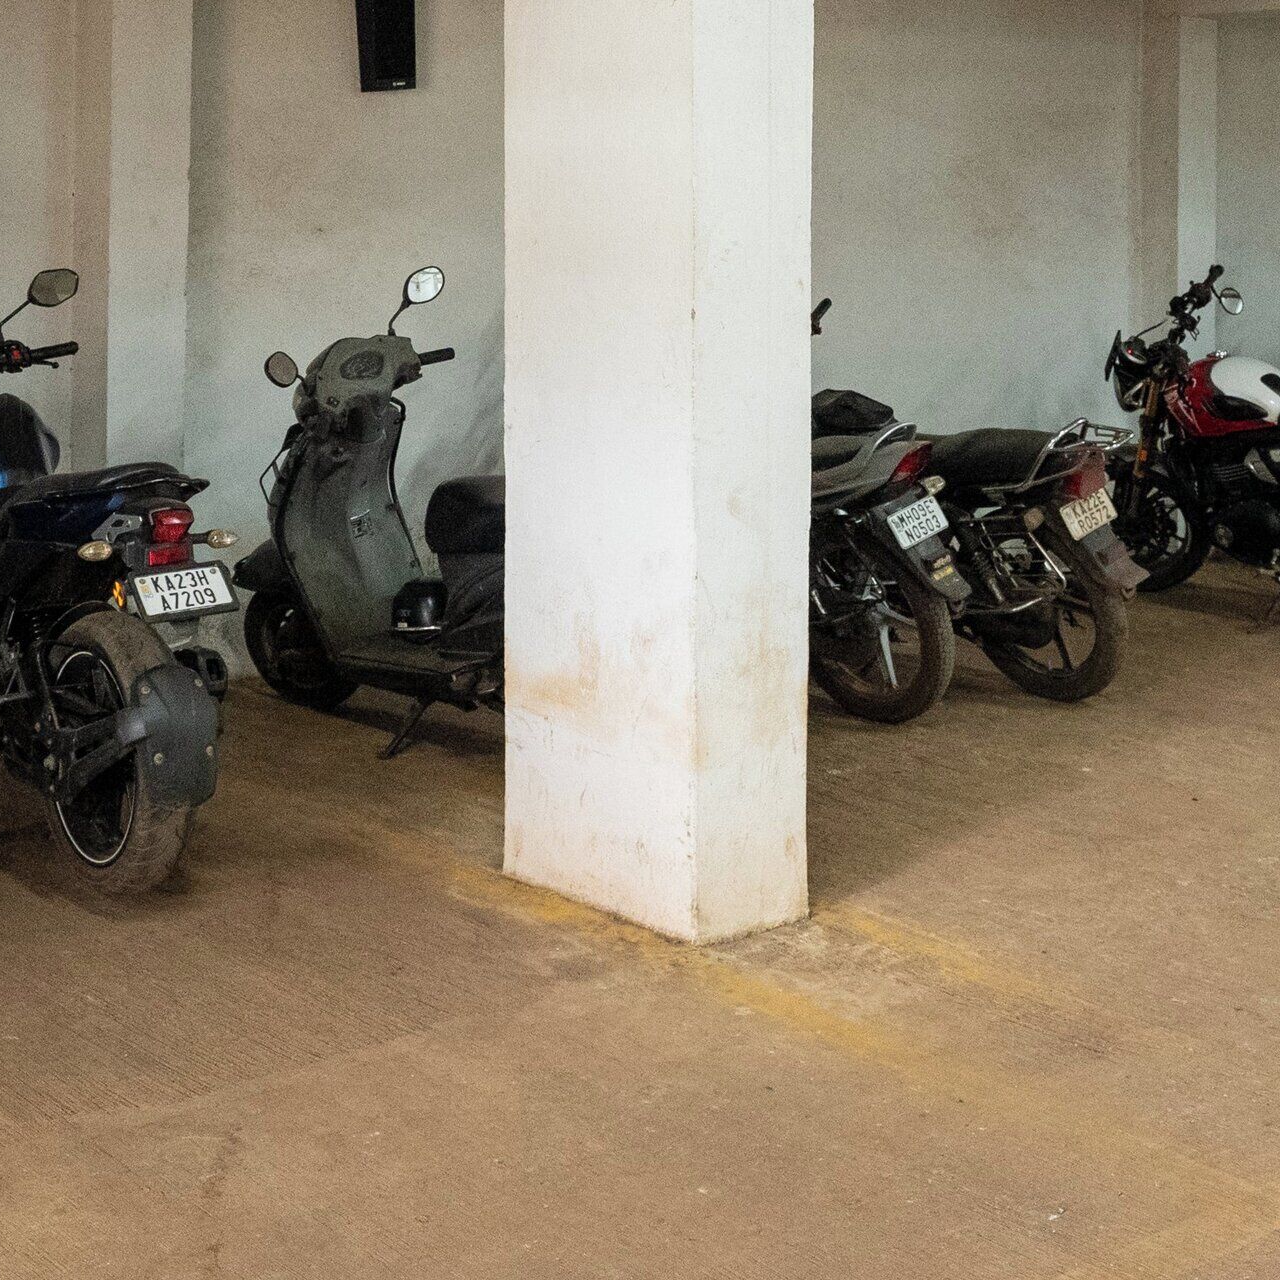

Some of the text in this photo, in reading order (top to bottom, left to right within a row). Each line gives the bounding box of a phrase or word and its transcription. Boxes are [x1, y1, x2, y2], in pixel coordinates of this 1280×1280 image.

[896, 500, 935, 528] MH09E
[1071, 491, 1106, 520] KA22E
[1077, 505, 1112, 534] R0572
[904, 514, 942, 543] N0503
[150, 569, 210, 593] KA23H
[160, 587, 217, 612] A7209
